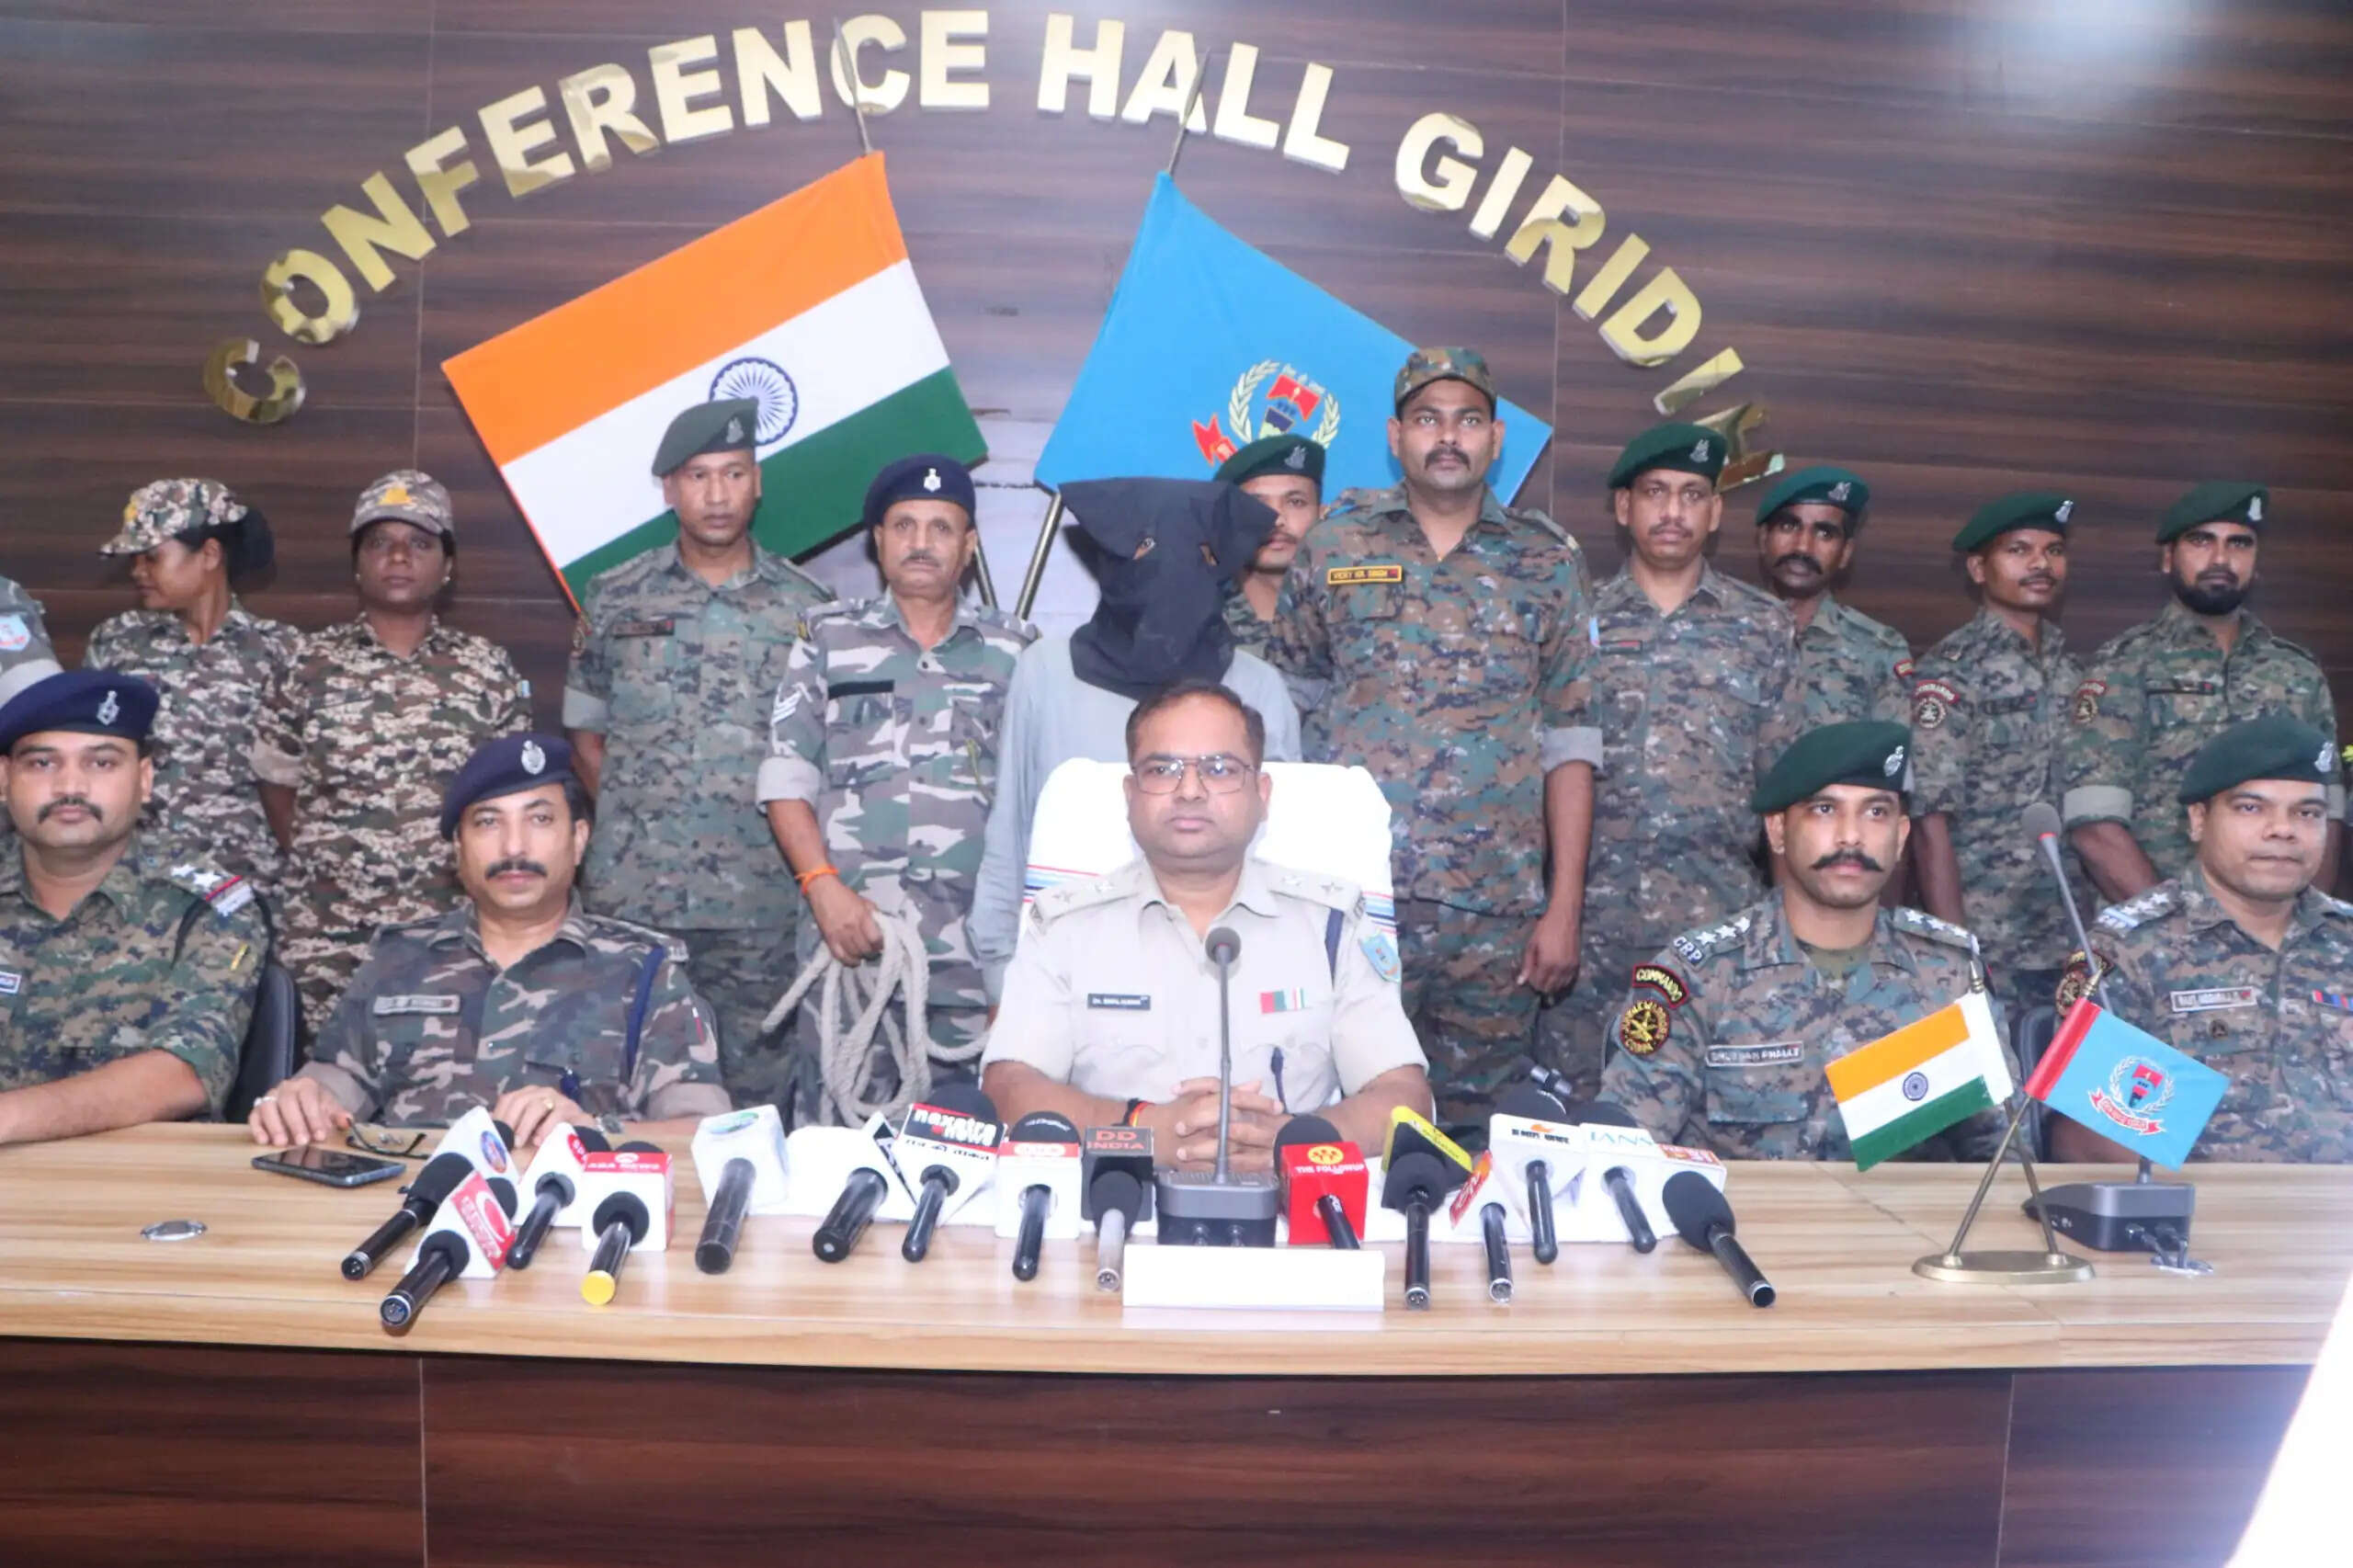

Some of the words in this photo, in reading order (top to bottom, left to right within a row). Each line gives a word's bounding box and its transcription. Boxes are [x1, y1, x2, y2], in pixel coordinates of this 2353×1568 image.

[202, 10, 990, 426] CONFERENCE
[1036, 13, 1350, 175] HALL
[1673, 936, 1703, 964] CRP
[1635, 968, 1684, 1003] COMMANDO
[1086, 1142, 1145, 1150] INDIA
[1096, 1130, 1138, 1141] DD
